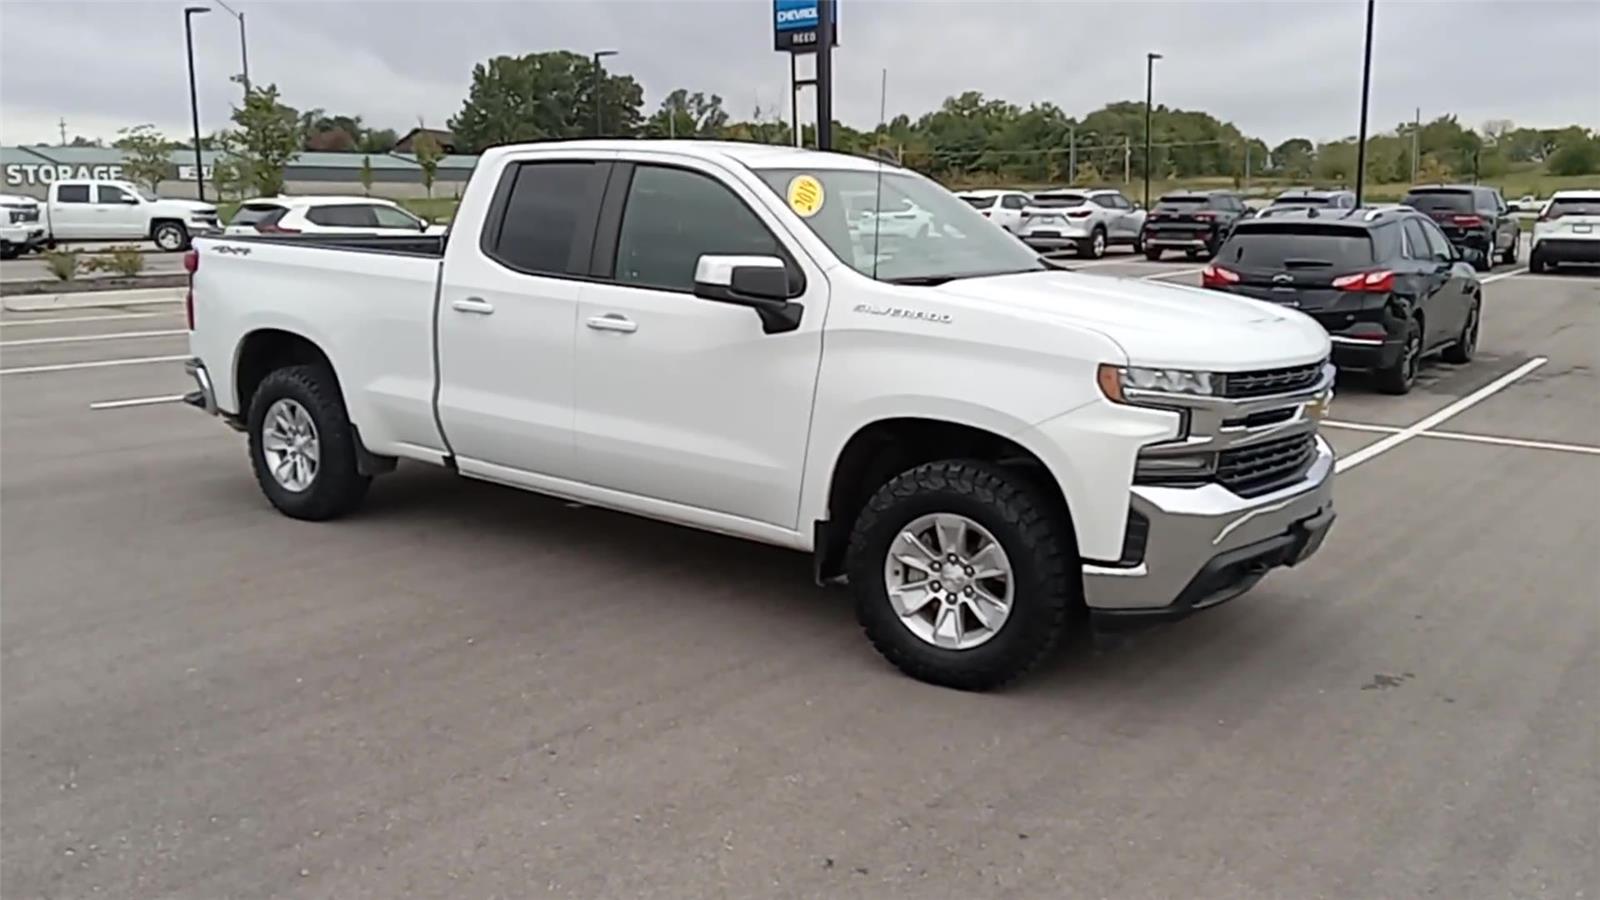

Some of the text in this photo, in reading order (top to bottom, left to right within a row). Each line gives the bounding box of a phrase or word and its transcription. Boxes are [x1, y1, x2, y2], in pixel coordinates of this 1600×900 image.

[7, 164, 122, 185] STORAGE
[794, 179, 818, 211] 2019
[853, 304, 954, 324] SILVERADO
